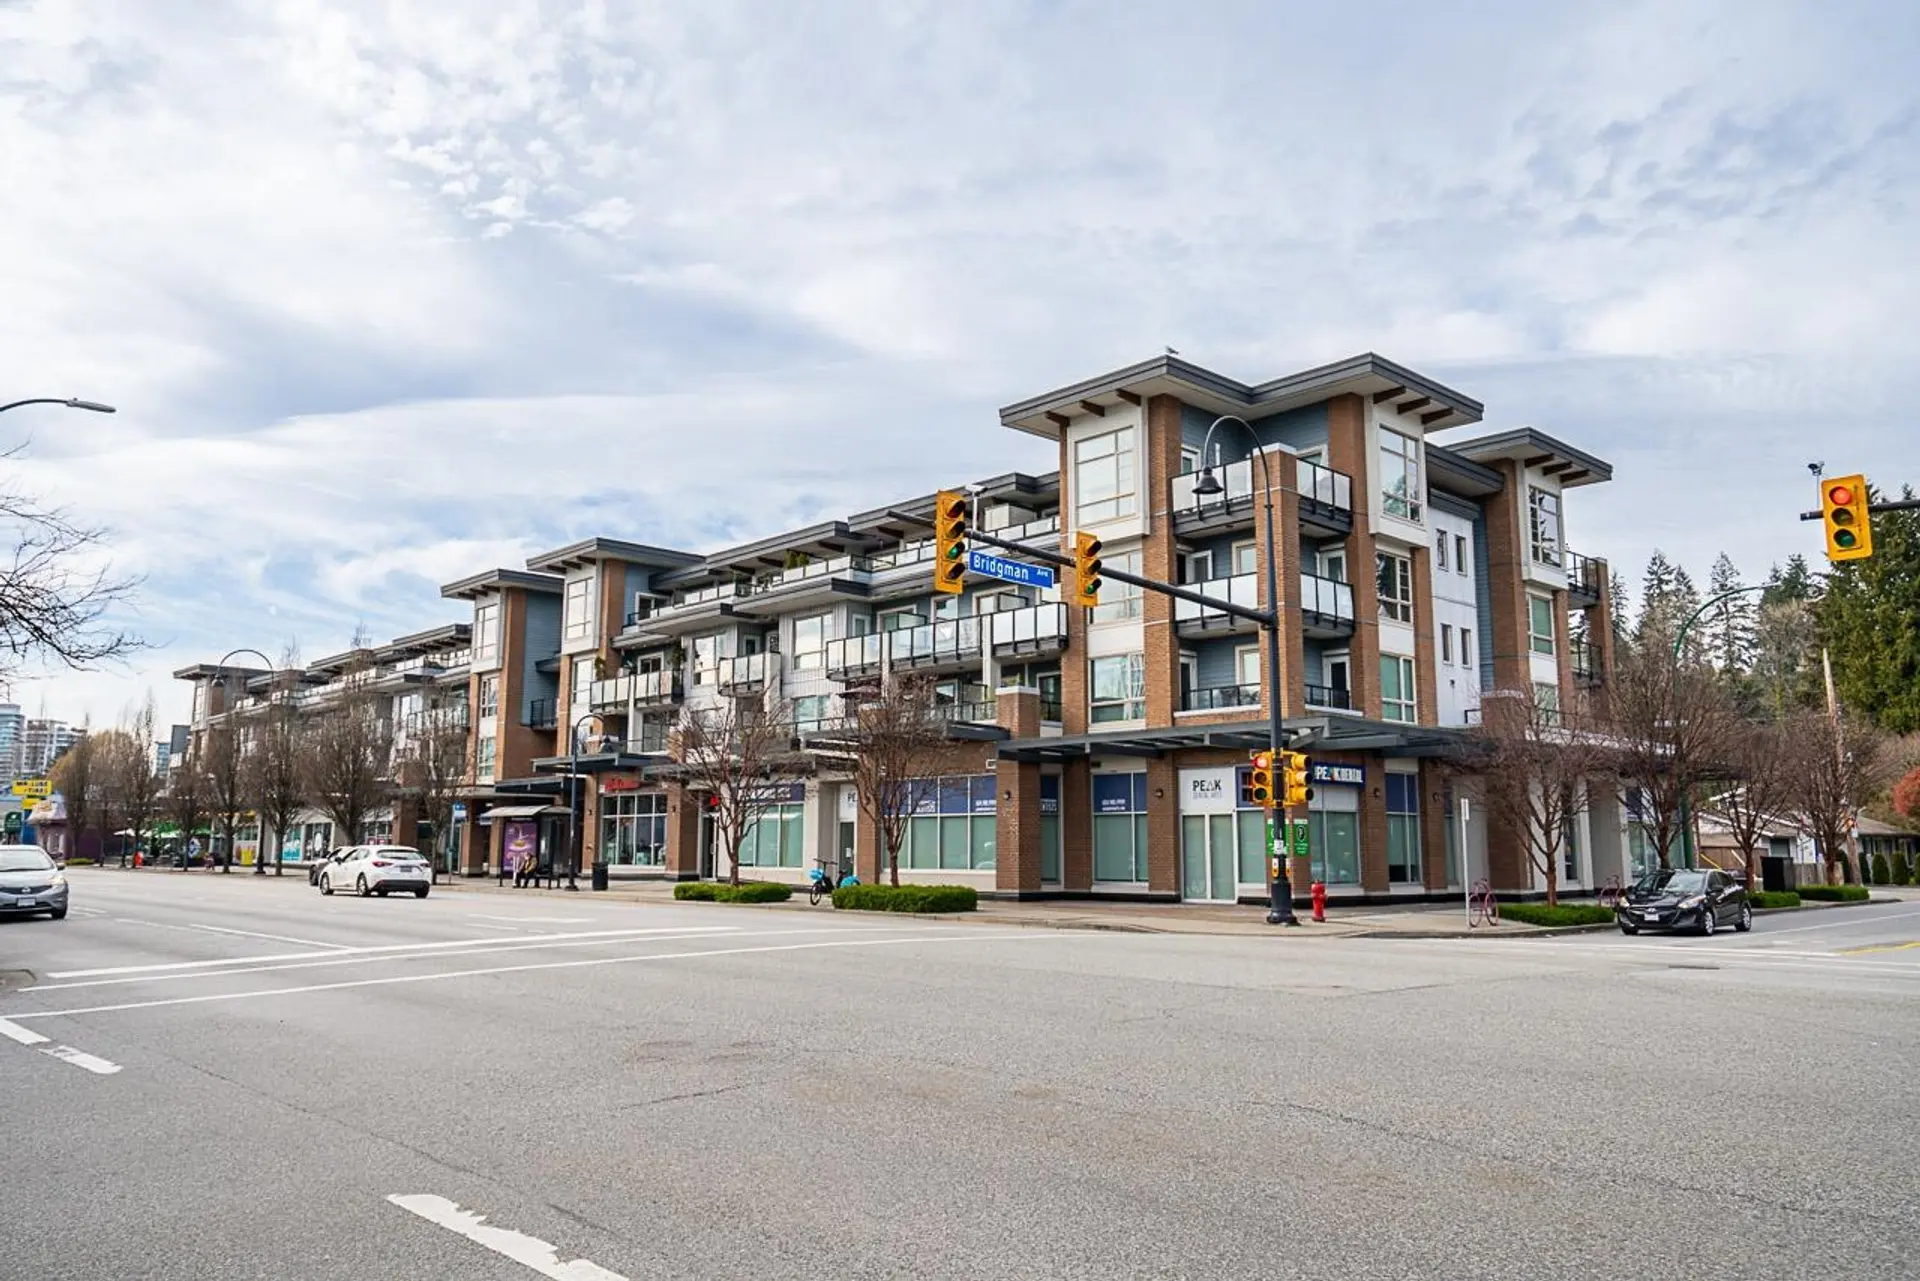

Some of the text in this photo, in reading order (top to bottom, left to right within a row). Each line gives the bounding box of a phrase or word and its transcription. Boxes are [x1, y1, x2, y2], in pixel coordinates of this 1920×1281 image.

[973, 554, 1049, 580] Bridgman Ave
[1315, 766, 1340, 782] PEAK
[1192, 779, 1222, 792] PEAK
